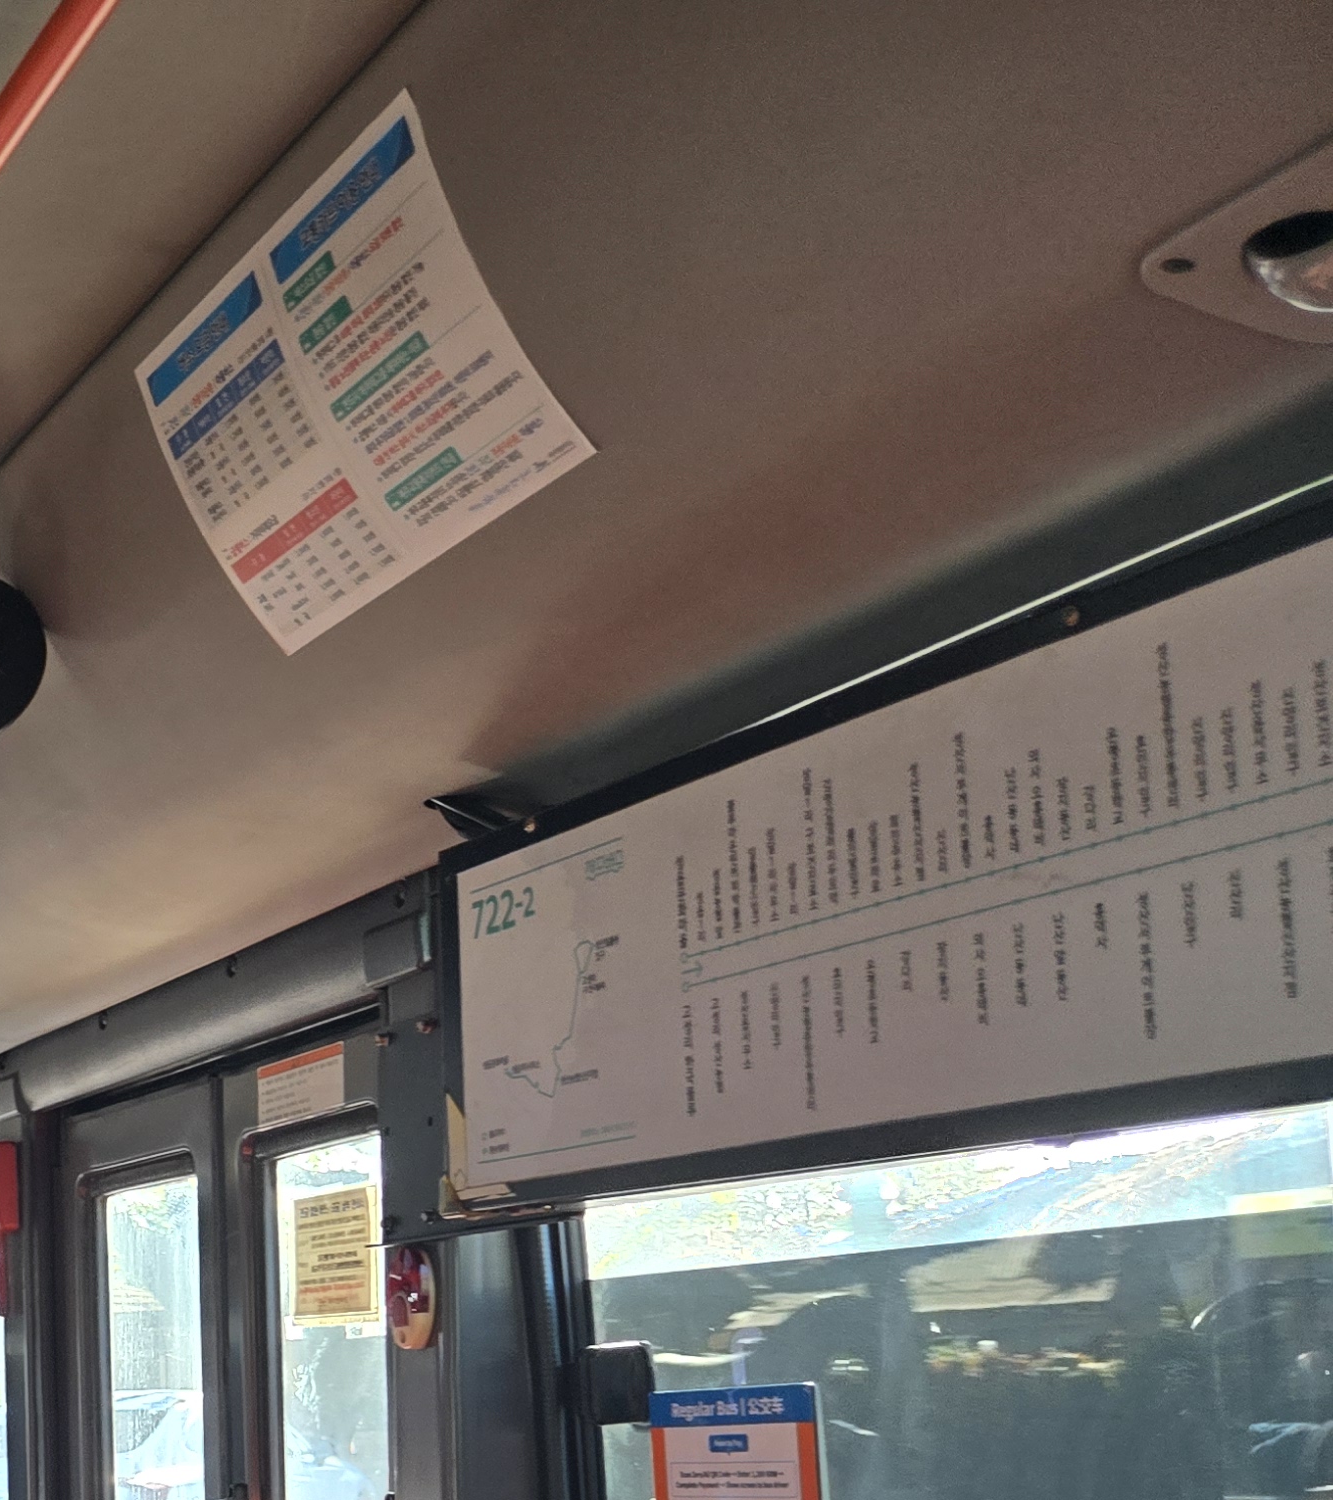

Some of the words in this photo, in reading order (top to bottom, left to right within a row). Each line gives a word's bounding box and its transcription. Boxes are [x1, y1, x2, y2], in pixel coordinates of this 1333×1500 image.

[470, 885, 537, 940] 722-2
[670, 1401, 715, 1422] Regular
[716, 1400, 739, 1417] Bus
